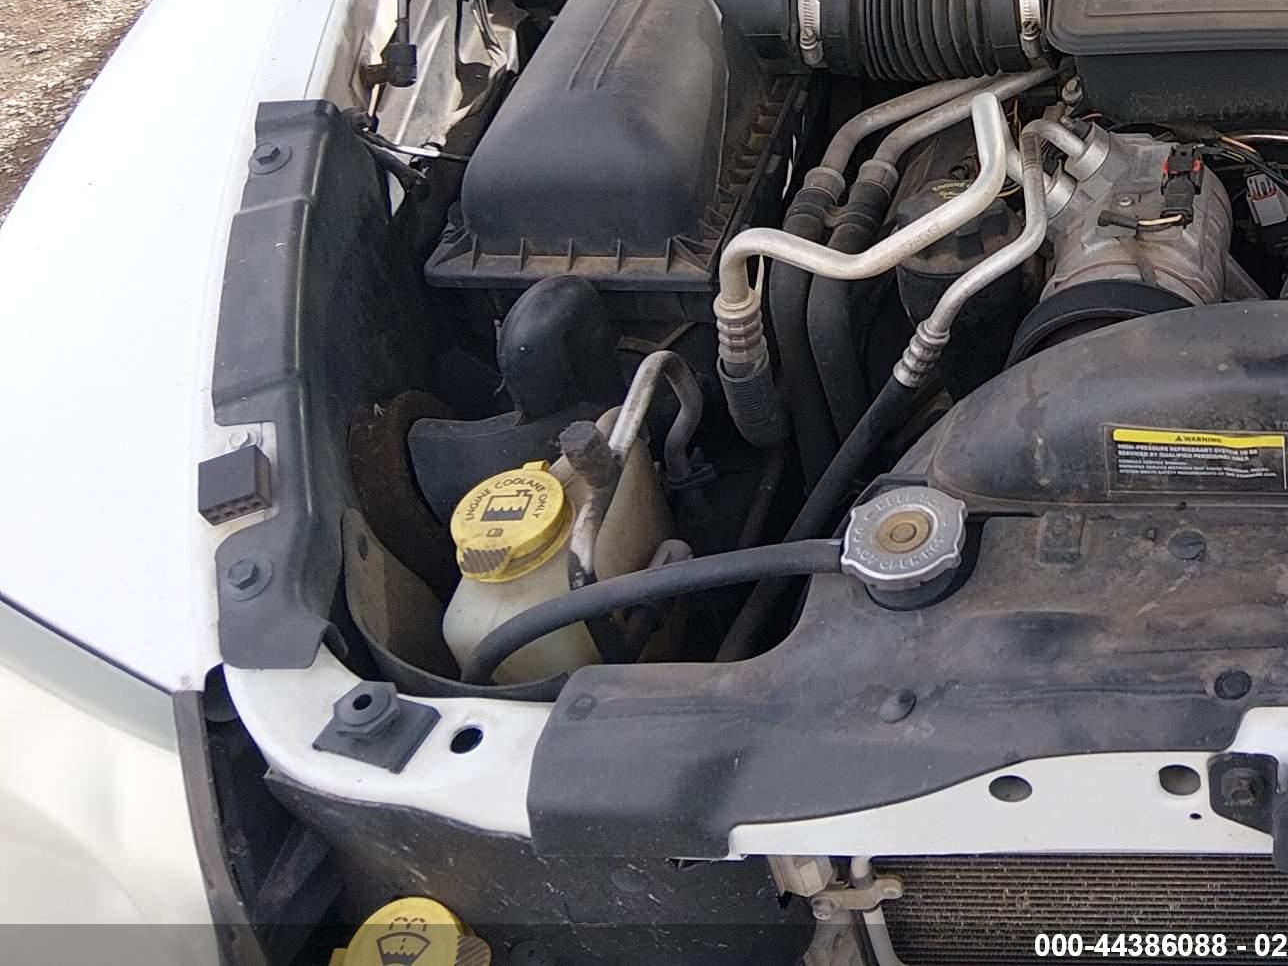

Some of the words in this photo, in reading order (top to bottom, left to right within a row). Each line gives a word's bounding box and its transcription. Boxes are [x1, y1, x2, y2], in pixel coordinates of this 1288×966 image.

[1184, 435, 1222, 444] WARNING
[464, 488, 493, 522] ENGINE
[494, 477, 548, 493] COOLANT
[532, 493, 549, 519] ONLY
